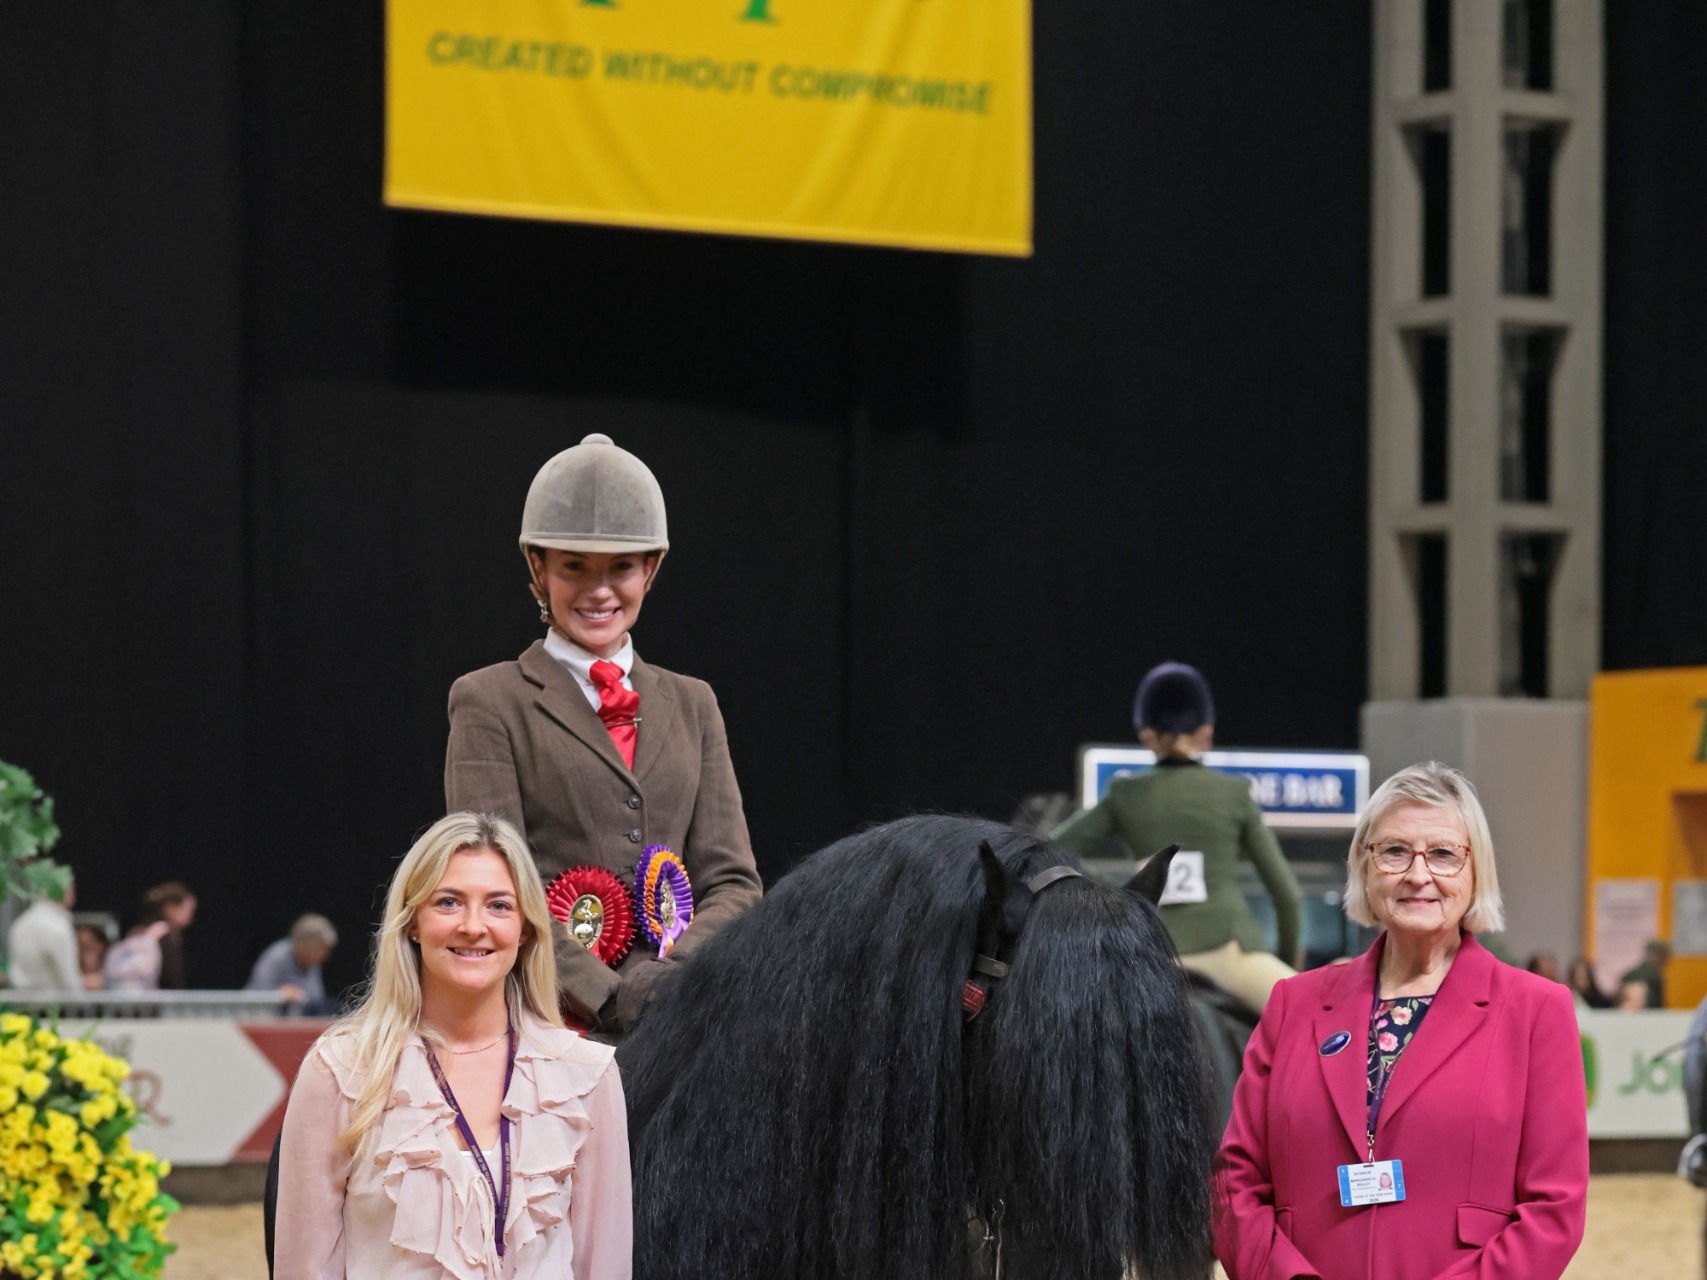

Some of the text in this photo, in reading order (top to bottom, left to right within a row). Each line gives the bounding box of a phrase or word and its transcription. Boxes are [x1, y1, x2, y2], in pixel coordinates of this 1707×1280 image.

[426, 31, 992, 117] CREATED WITHOUT COMPROMISE
[1283, 773, 1345, 808] BAR
